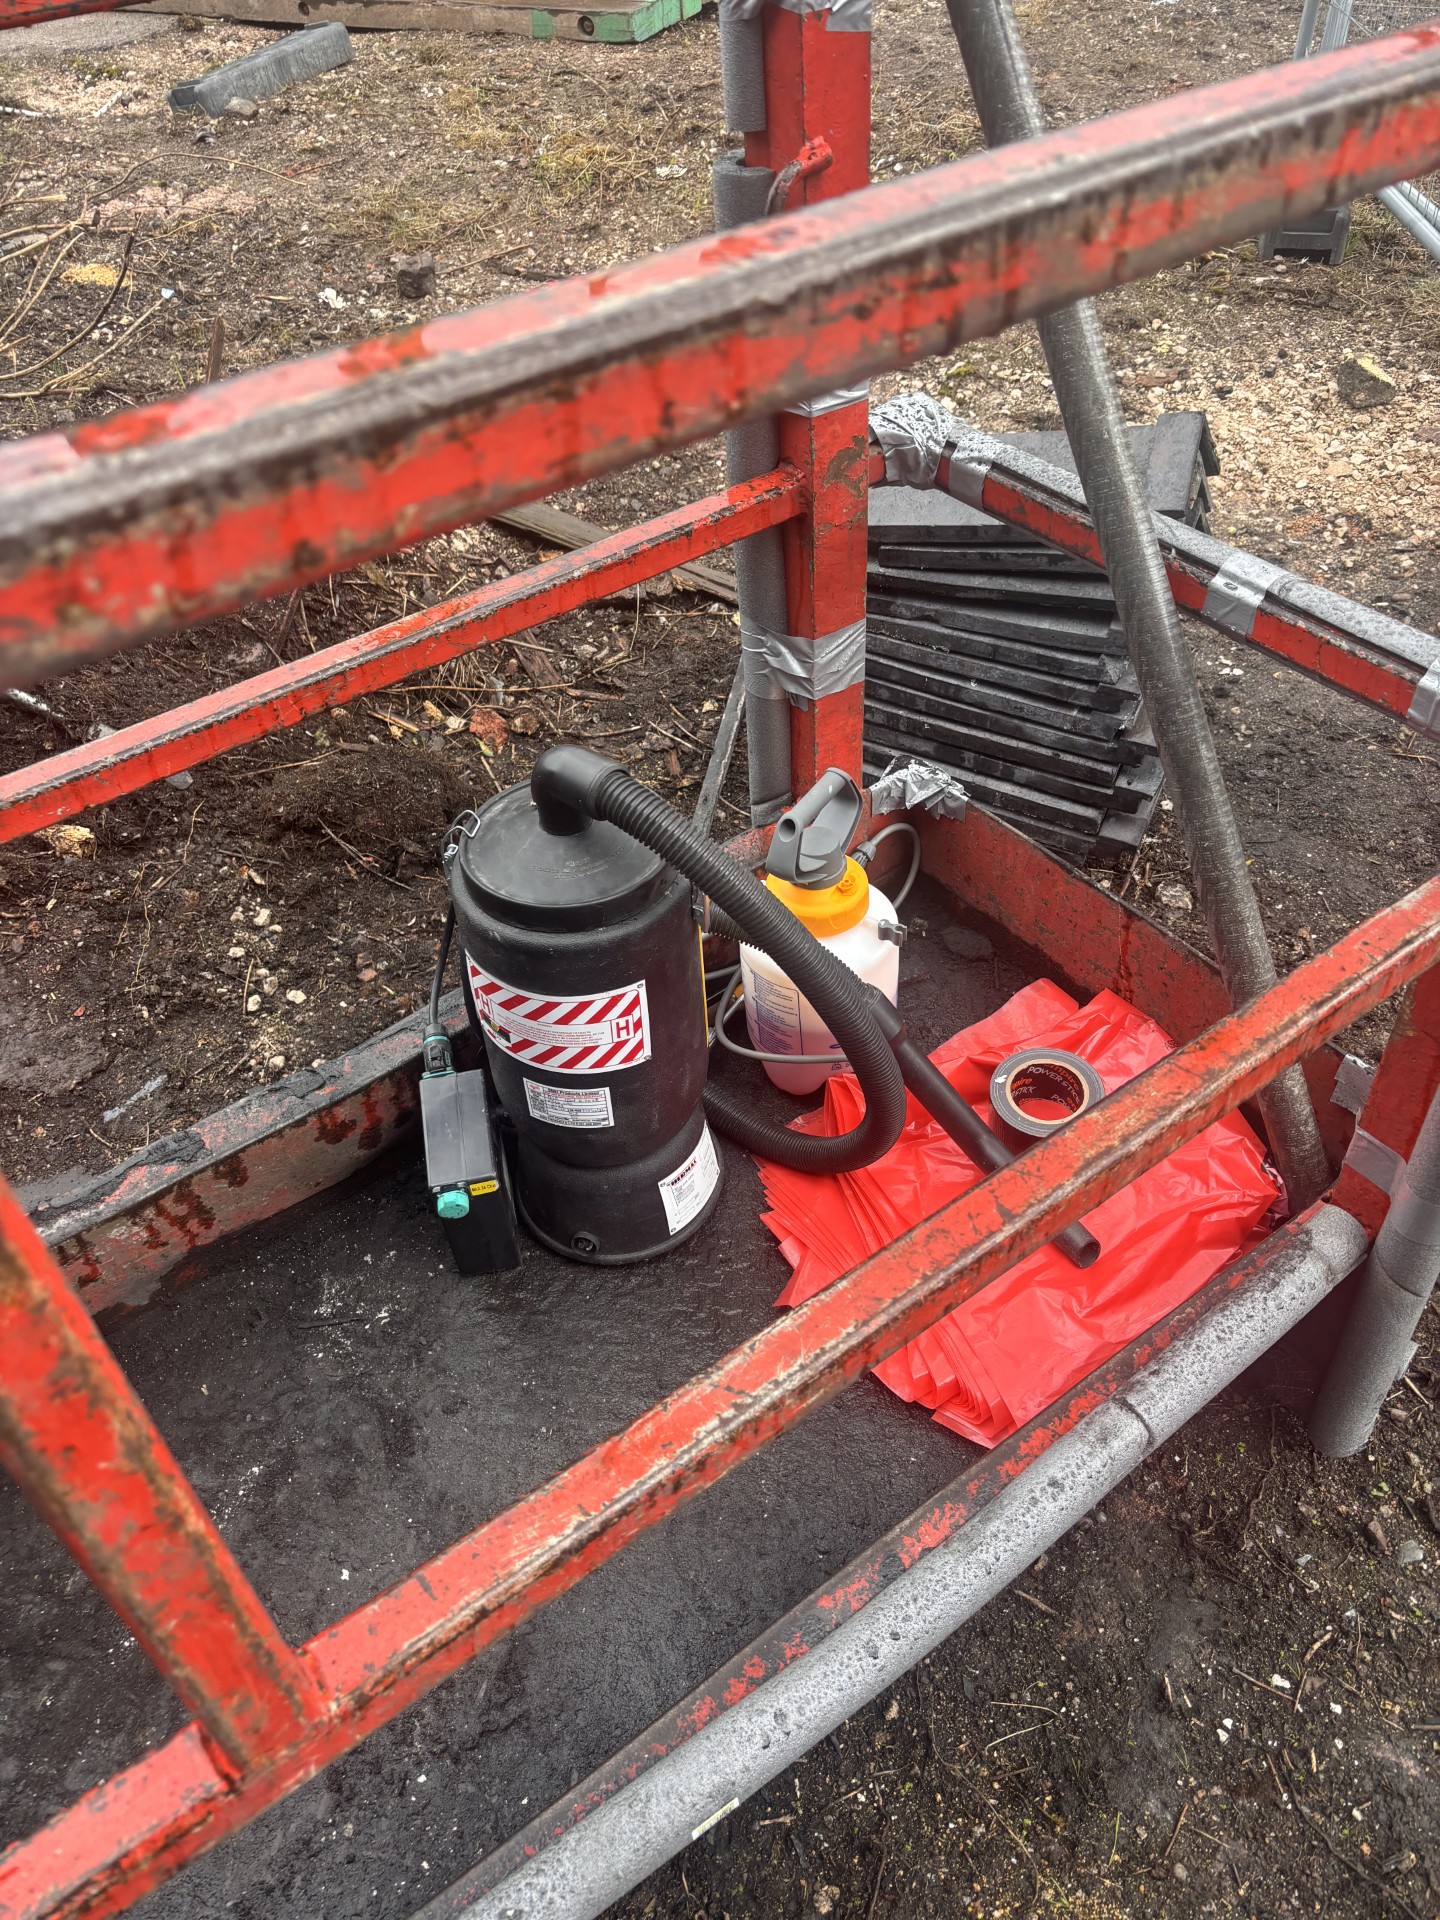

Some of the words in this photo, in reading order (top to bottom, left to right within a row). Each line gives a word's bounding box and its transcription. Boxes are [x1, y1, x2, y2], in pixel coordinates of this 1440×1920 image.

[480, 993, 491, 1015] H
[615, 1019, 630, 1039] H
[1027, 1066, 1062, 1082] POWER
[1061, 1080, 1080, 1105] STICK
